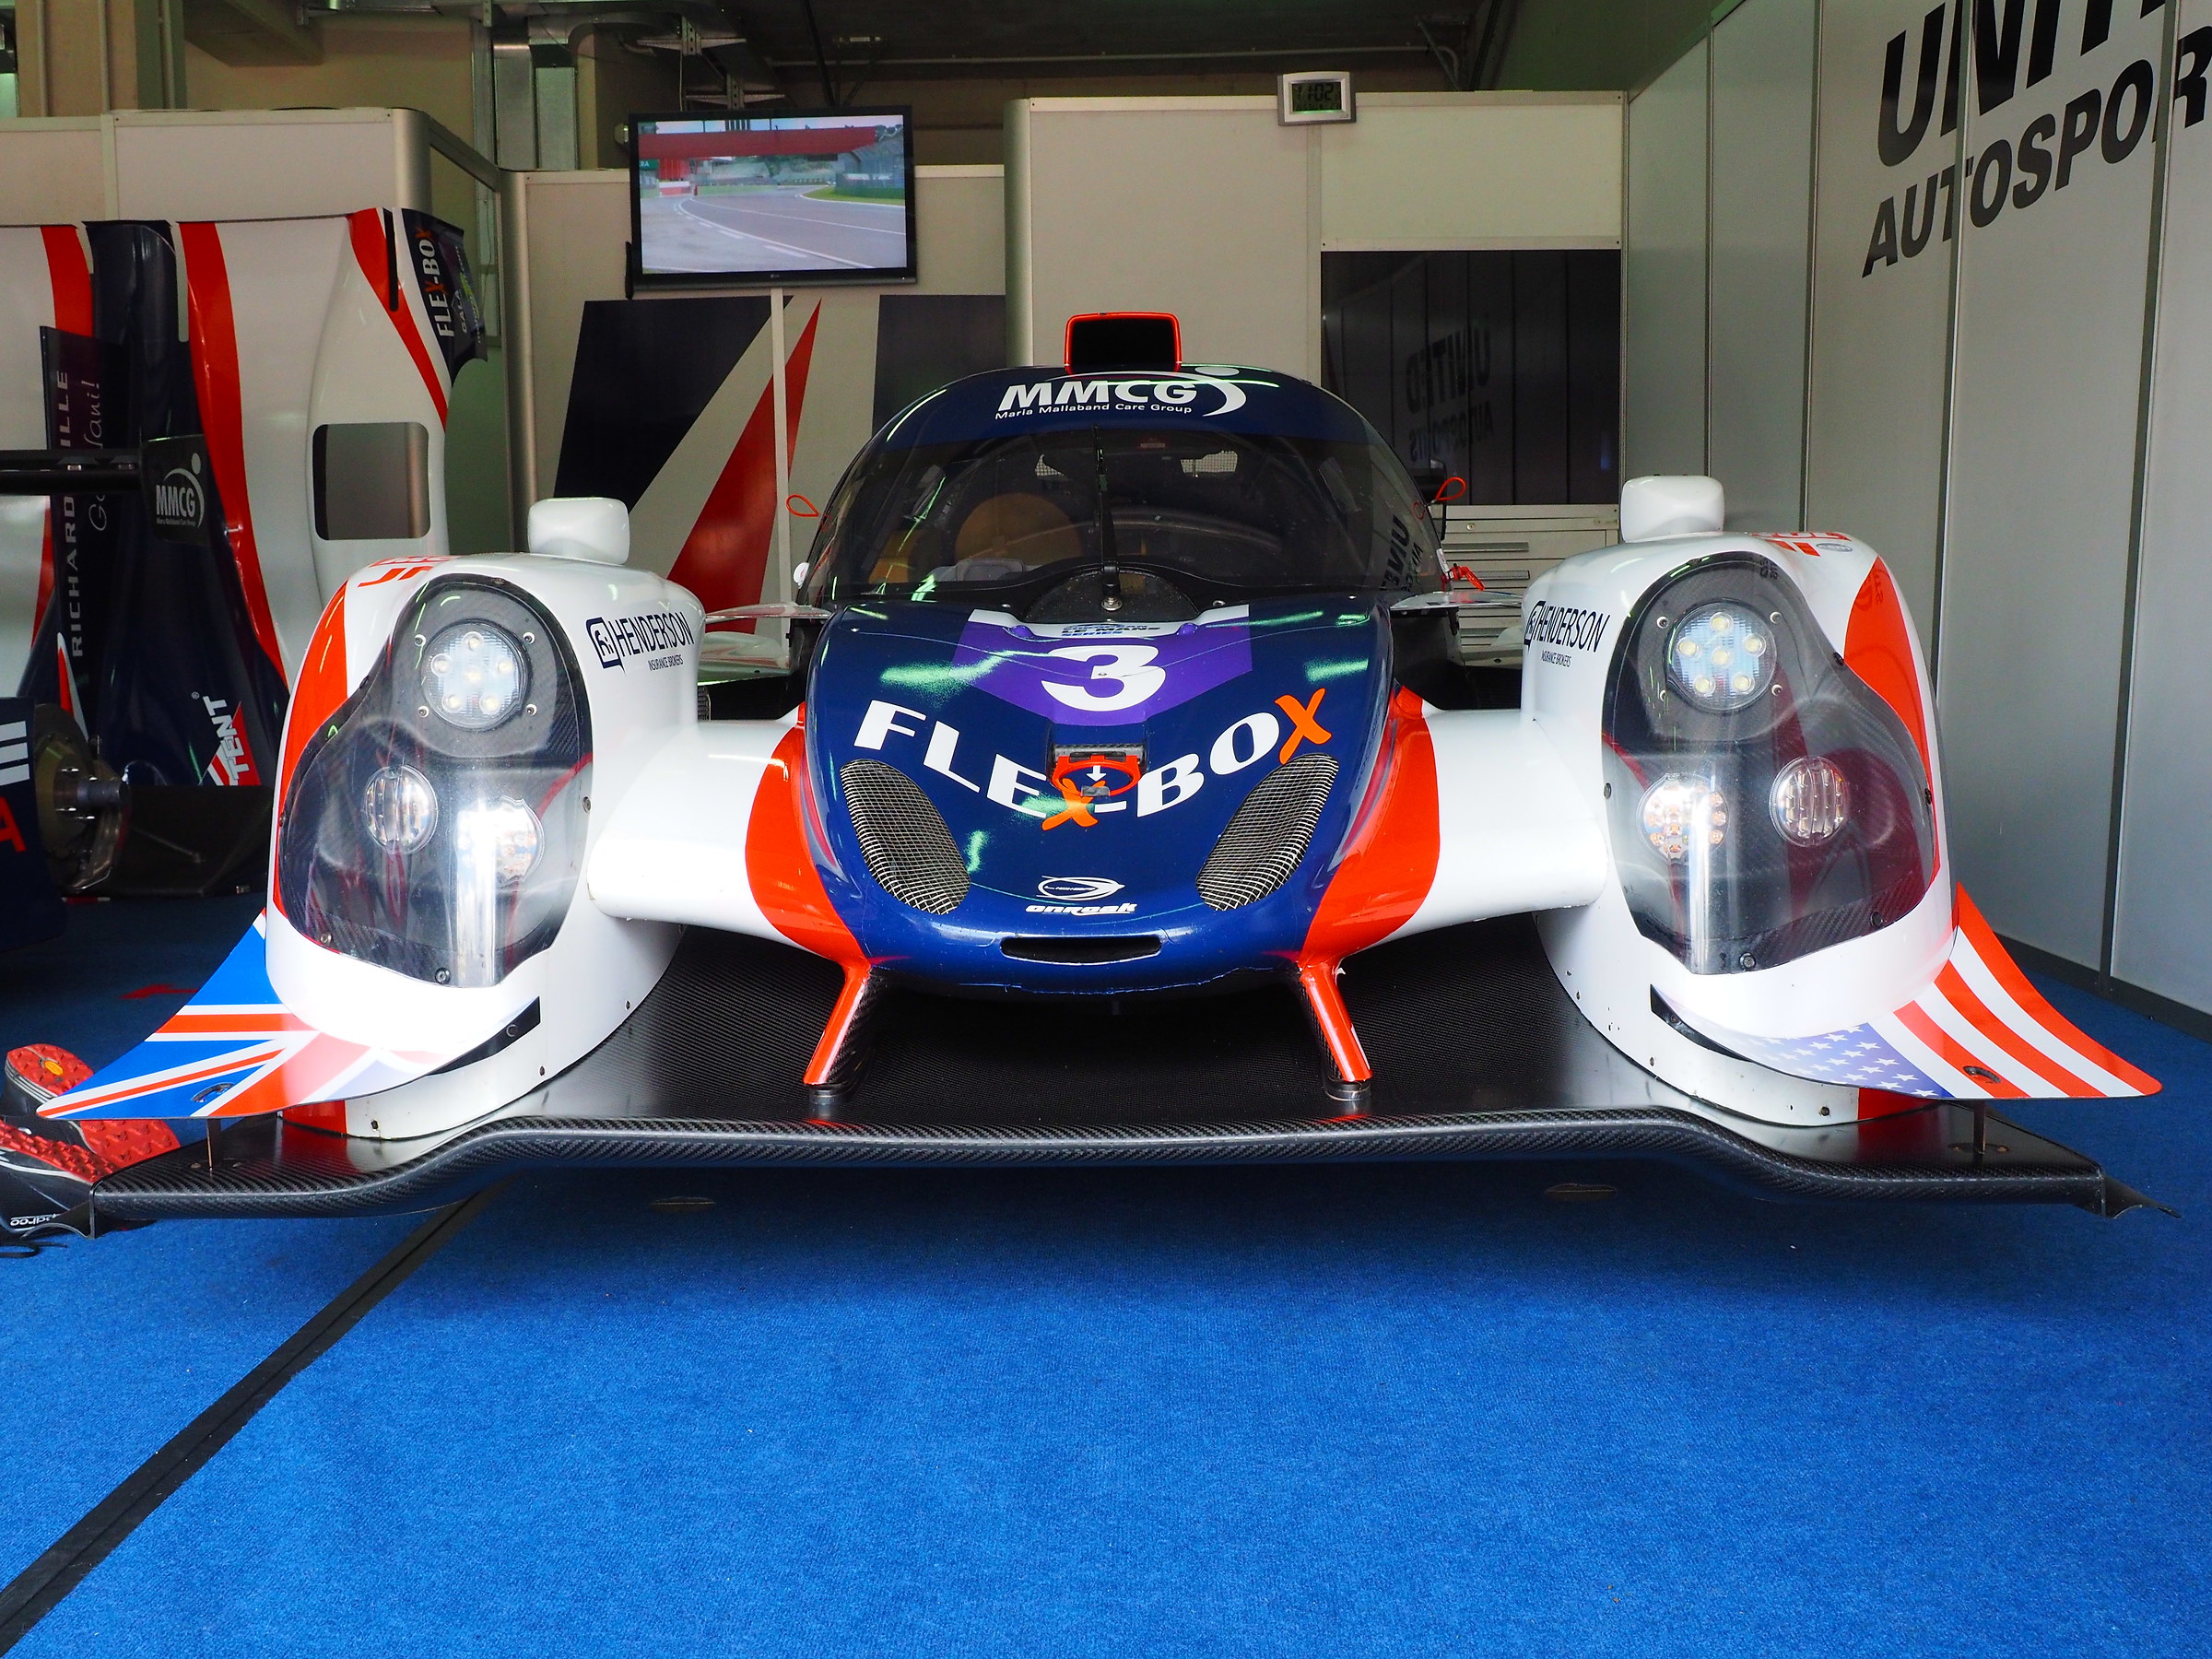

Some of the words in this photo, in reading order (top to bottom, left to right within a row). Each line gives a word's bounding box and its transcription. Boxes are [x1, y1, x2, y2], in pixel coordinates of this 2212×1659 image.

[994, 408, 1033, 420] Maria
[1039, 403, 1111, 415] Mallaband
[1114, 403, 1146, 412] Care
[1150, 404, 1193, 415] Group
[998, 380, 1198, 412] MMCG
[156, 485, 196, 518] MMCG
[64, 496, 84, 657] RICHARD
[608, 612, 694, 656] HENDERSON
[1533, 606, 1611, 653] HENDERSON
[1041, 644, 1167, 712] 3
[853, 688, 1333, 831] FLEX-BOX
